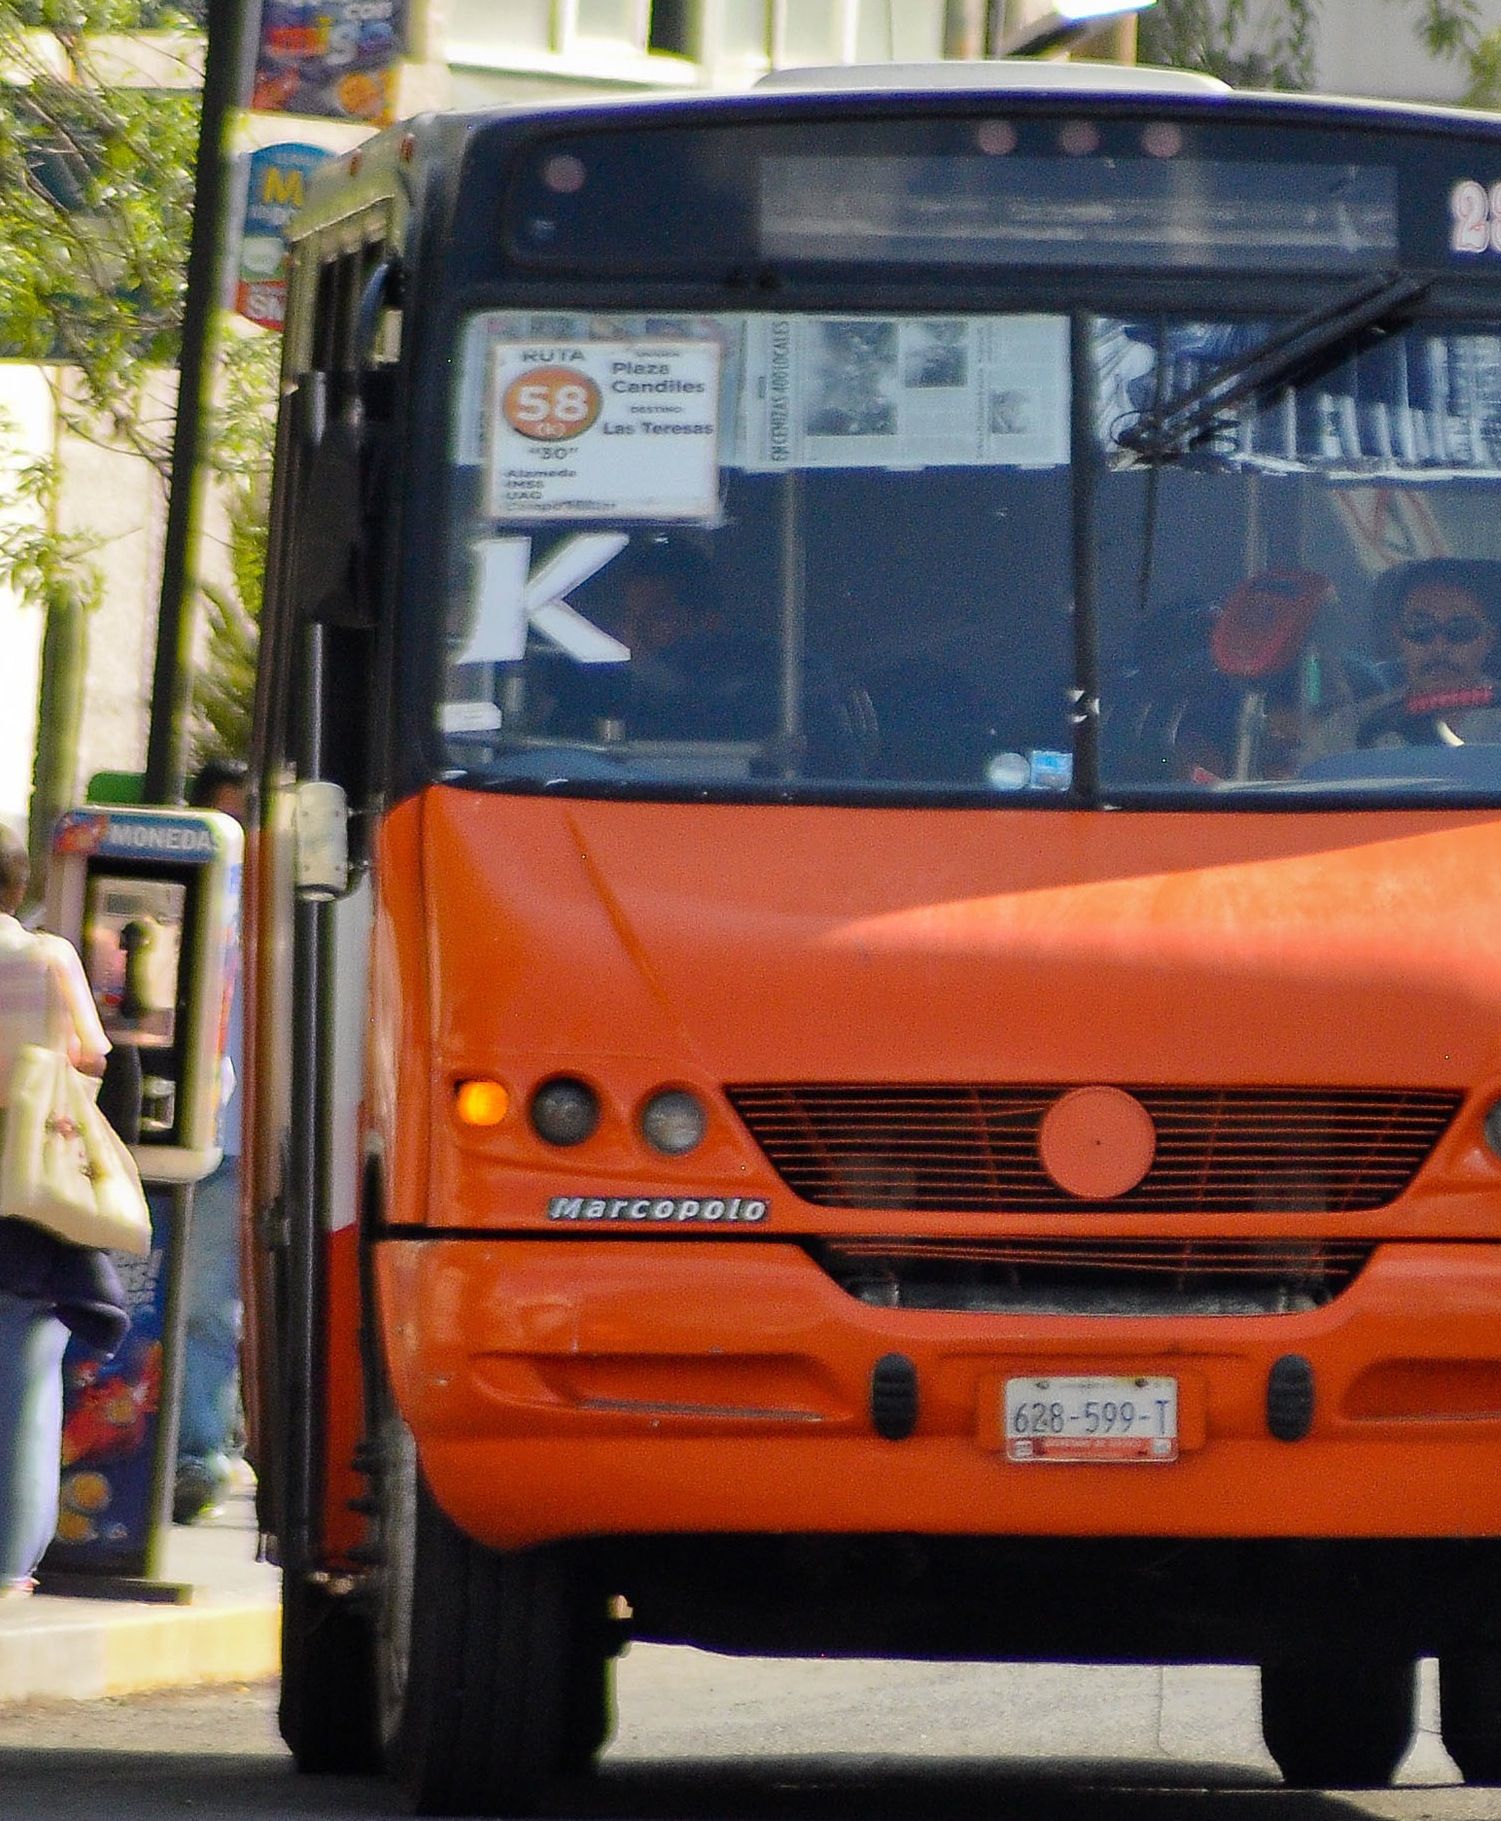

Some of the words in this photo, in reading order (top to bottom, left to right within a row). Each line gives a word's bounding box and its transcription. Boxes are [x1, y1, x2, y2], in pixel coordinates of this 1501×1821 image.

[522, 350, 586, 362] RUTA
[611, 361, 670, 376] Plaza
[610, 379, 706, 394] Candiles
[517, 384, 589, 422] 58
[603, 421, 636, 435] Las
[641, 421, 715, 435] Teresas
[504, 468, 578, 478] Alameda
[455, 531, 633, 665] K
[550, 1197, 768, 1222] Marcopolo
[1013, 1400, 1170, 1435] 628-599-T
